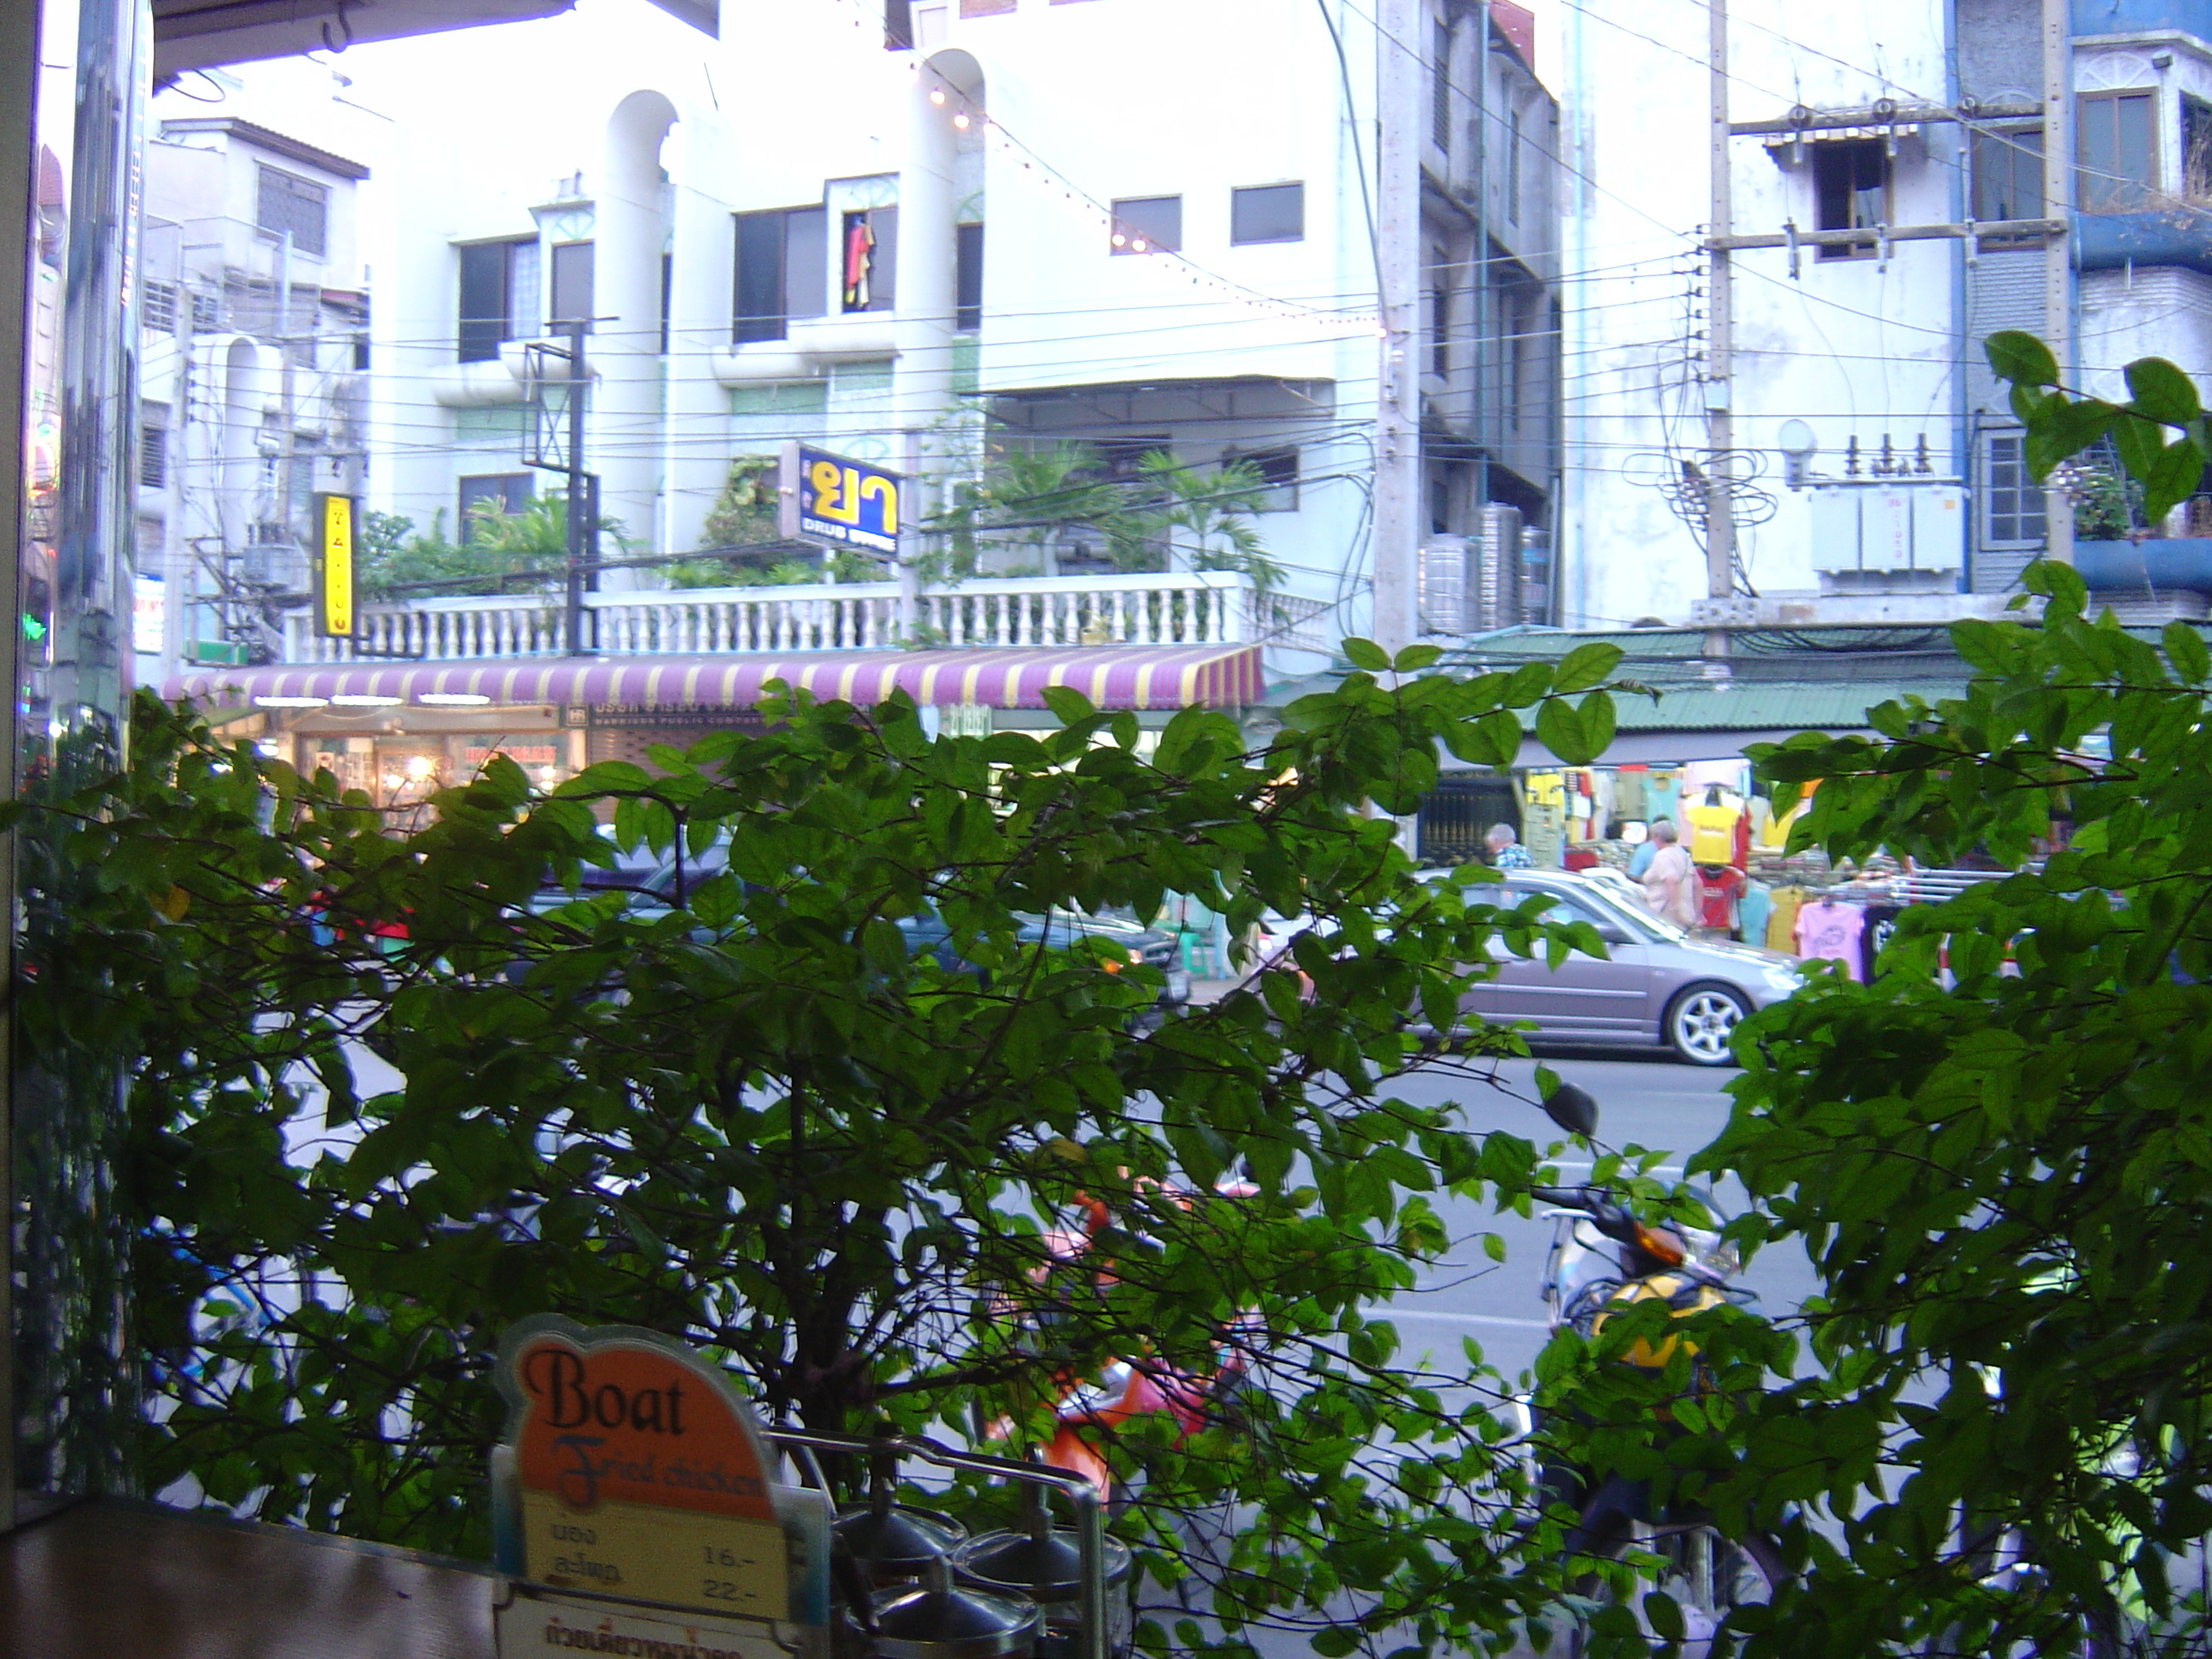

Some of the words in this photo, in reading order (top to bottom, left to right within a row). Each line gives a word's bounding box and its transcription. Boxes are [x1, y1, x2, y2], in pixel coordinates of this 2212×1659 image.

[802, 518, 847, 538] DRUG
[812, 462, 897, 533] ยา
[524, 1348, 685, 1435] Boat
